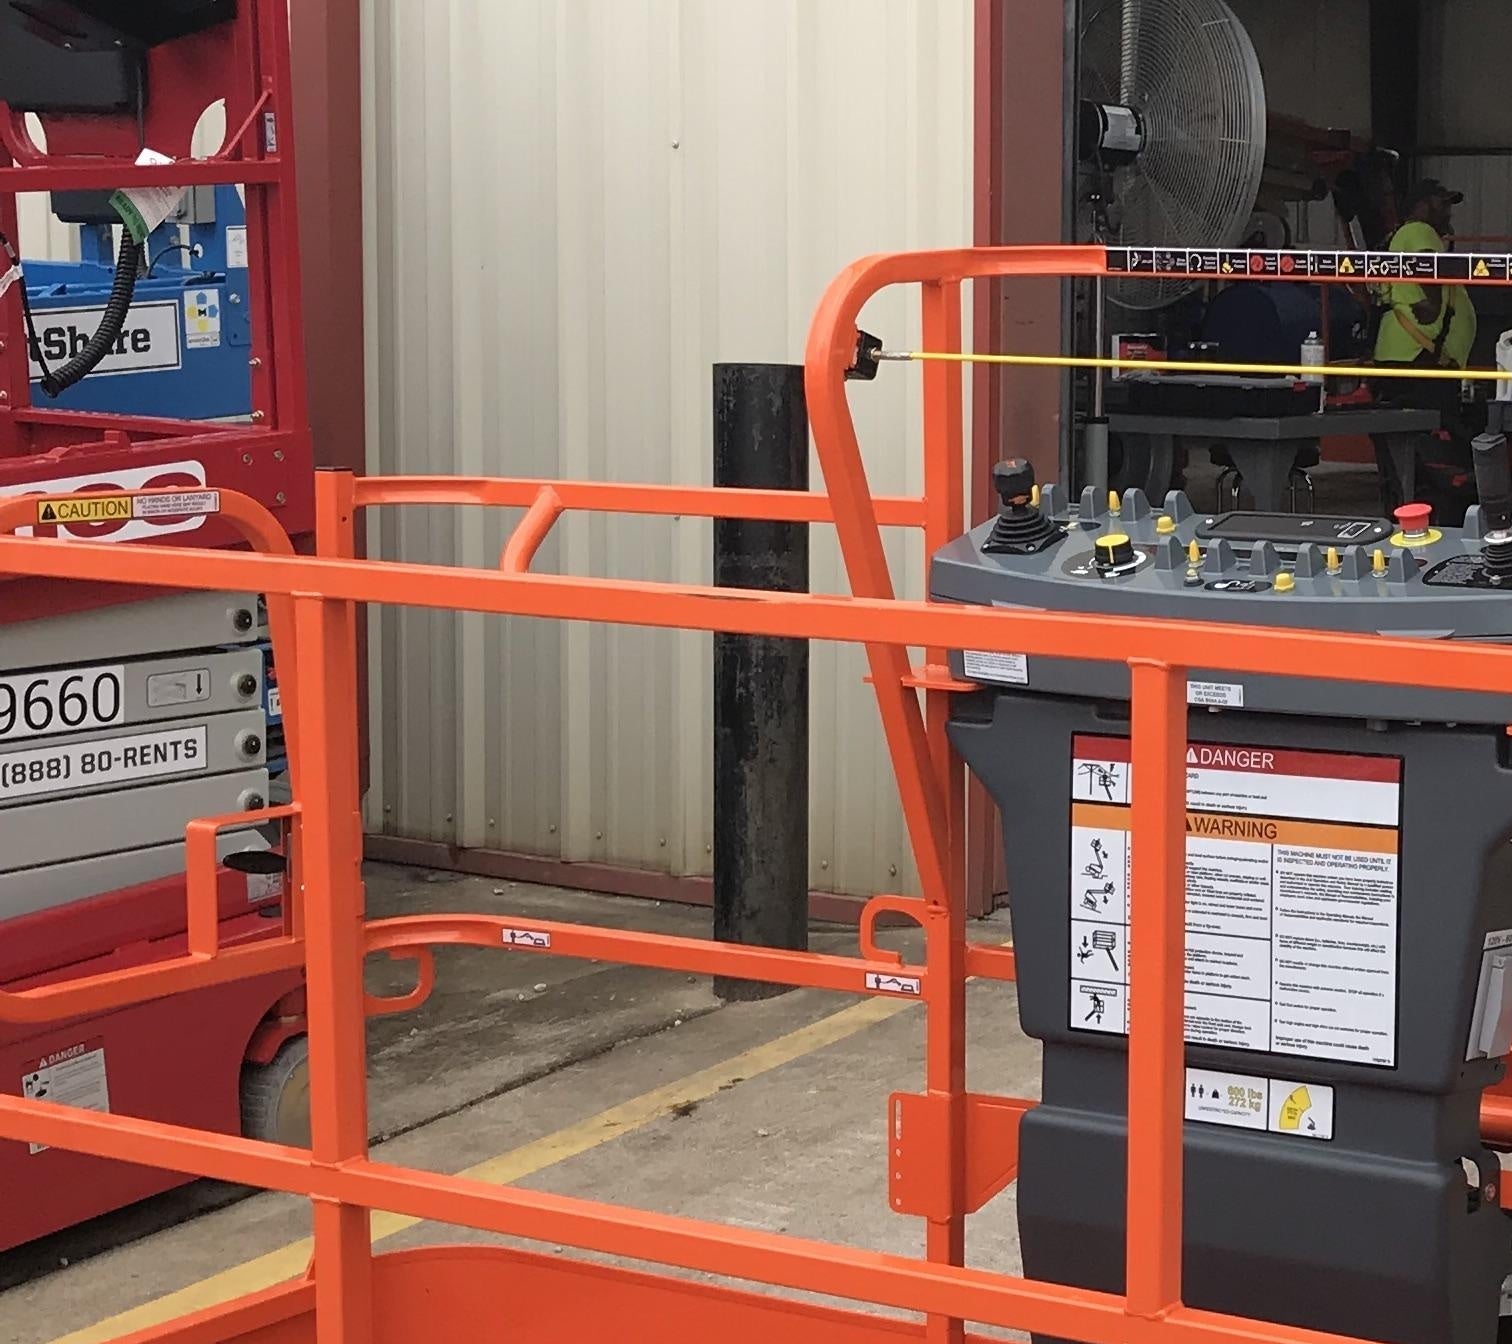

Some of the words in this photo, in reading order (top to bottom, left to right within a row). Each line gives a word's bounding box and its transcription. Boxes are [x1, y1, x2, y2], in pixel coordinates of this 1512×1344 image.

[57, 500, 129, 519] CAUTION
[1, 754, 71, 788] (888)
[81, 738, 198, 774] 80-RENTS
[1200, 748, 1274, 769] DANGER
[1194, 817, 1277, 840] WARNING
[1326, 861, 1358, 870] OPERATING
[1370, 856, 1385, 864] UNTIL
[48, 1043, 86, 1064] DANGER
[1228, 1096, 1246, 1108] 272
[1248, 1099, 1262, 1112] kg
